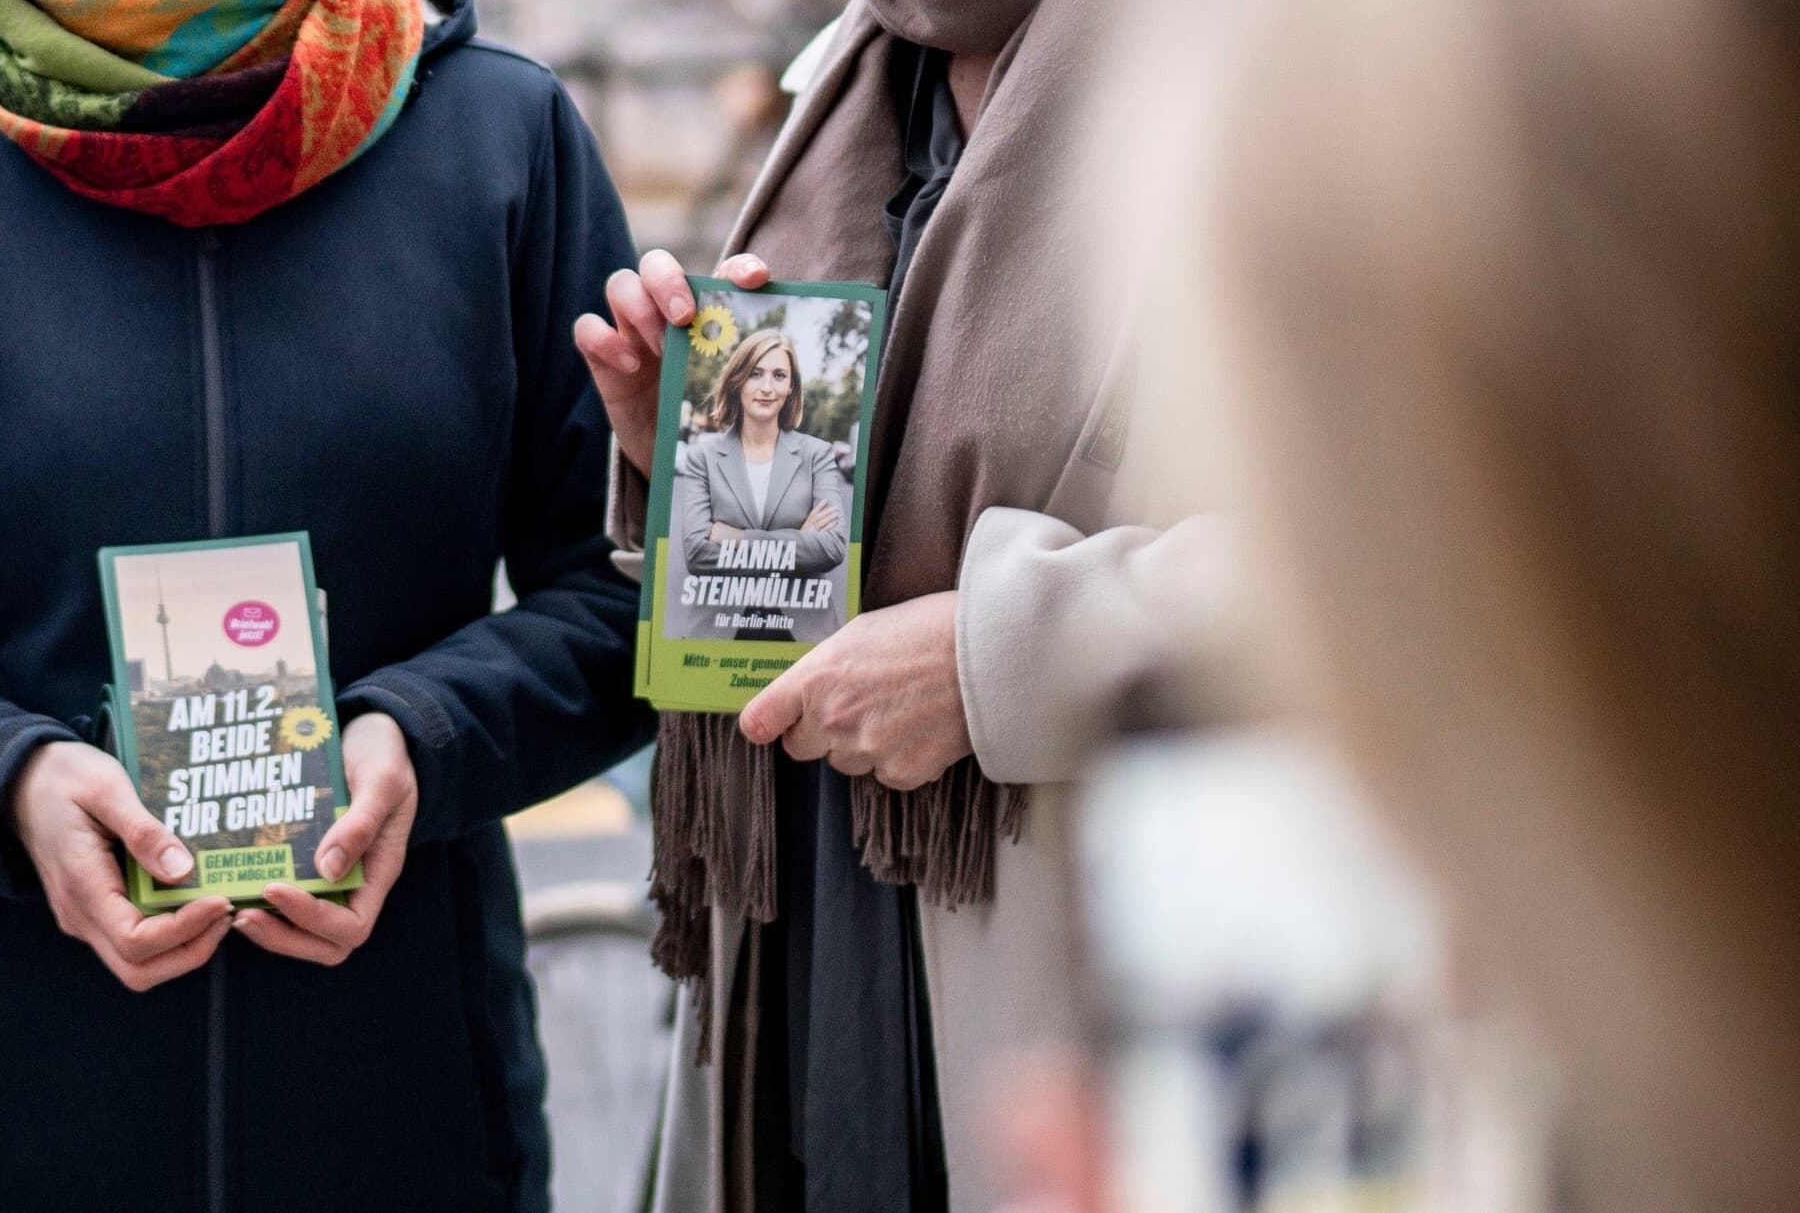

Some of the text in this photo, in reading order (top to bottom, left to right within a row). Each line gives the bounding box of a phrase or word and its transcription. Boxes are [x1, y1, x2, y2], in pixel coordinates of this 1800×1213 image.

[717, 539, 797, 570] HANNA
[680, 572, 833, 609] STEINMÜLLER
[715, 613, 795, 629] für Berlin-Mitte
[683, 653, 710, 668] Mitte
[168, 685, 283, 731] AM 11.2.
[190, 720, 272, 764] BEIDE
[168, 751, 303, 803] STIMMEN
[165, 785, 315, 838] FÜR GRÜN!
[205, 849, 287, 869] GEMEINSAM
